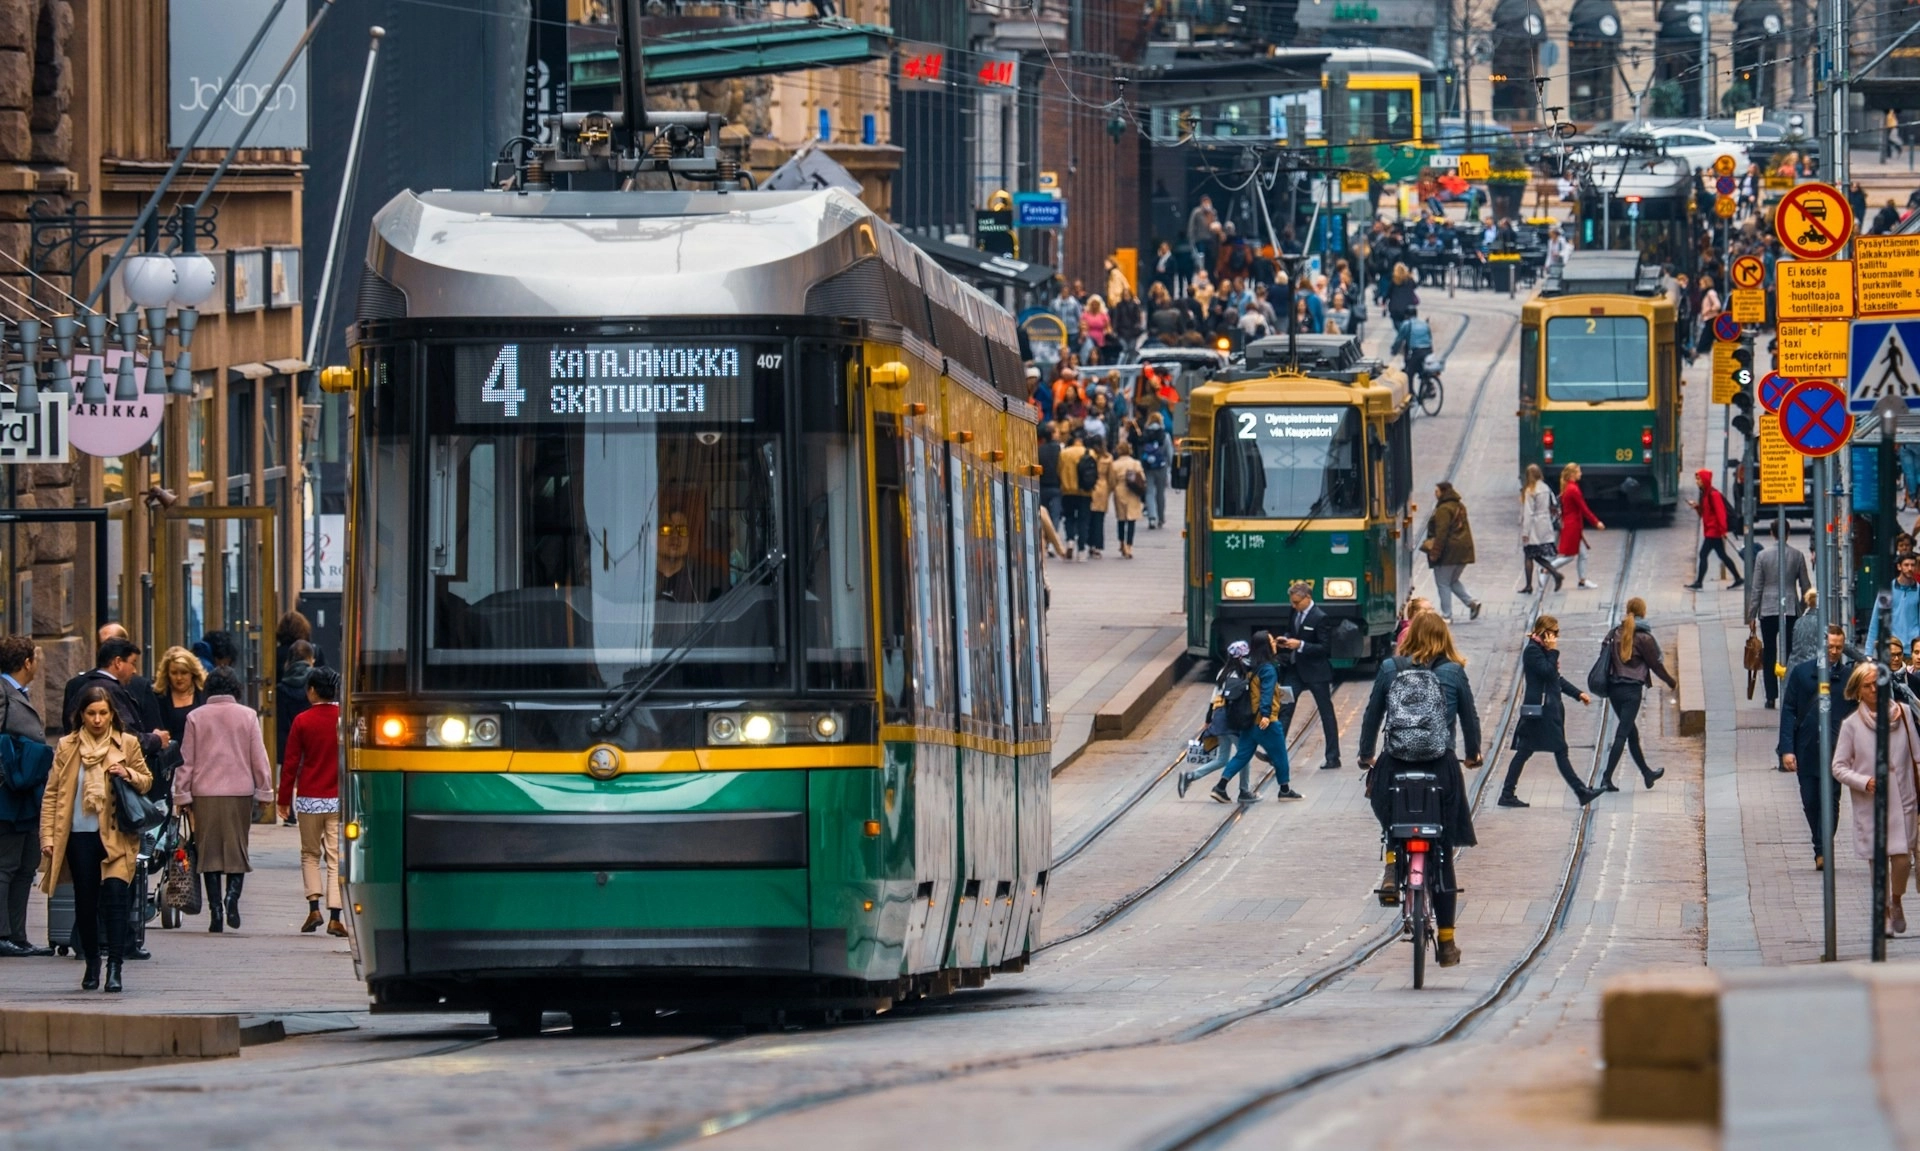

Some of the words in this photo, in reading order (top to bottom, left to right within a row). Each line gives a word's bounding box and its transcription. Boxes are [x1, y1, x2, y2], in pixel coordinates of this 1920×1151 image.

[1787, 267, 1796, 276] Ei
[1800, 266, 1827, 276] koske
[1860, 261, 1888, 269] sallittu
[1863, 280, 1902, 290] purkaville
[1864, 290, 1912, 300] ajoneuvoille
[1585, 319, 1596, 334] 2
[1781, 326, 1807, 336] Gäller
[1811, 326, 1821, 336] ej
[757, 354, 783, 369] 407
[482, 344, 526, 417] 4
[550, 349, 740, 378] KATAJANOKKA
[550, 384, 705, 414] SKATUDDEN
[68, 404, 149, 418] ARIKKA
[1238, 412, 1257, 439] 2
[1264, 413, 1338, 425] Olympiaterminaali
[1269, 428, 1284, 437] via
[1285, 427, 1332, 438] Kauppatori
[1616, 449, 1633, 461] 89
